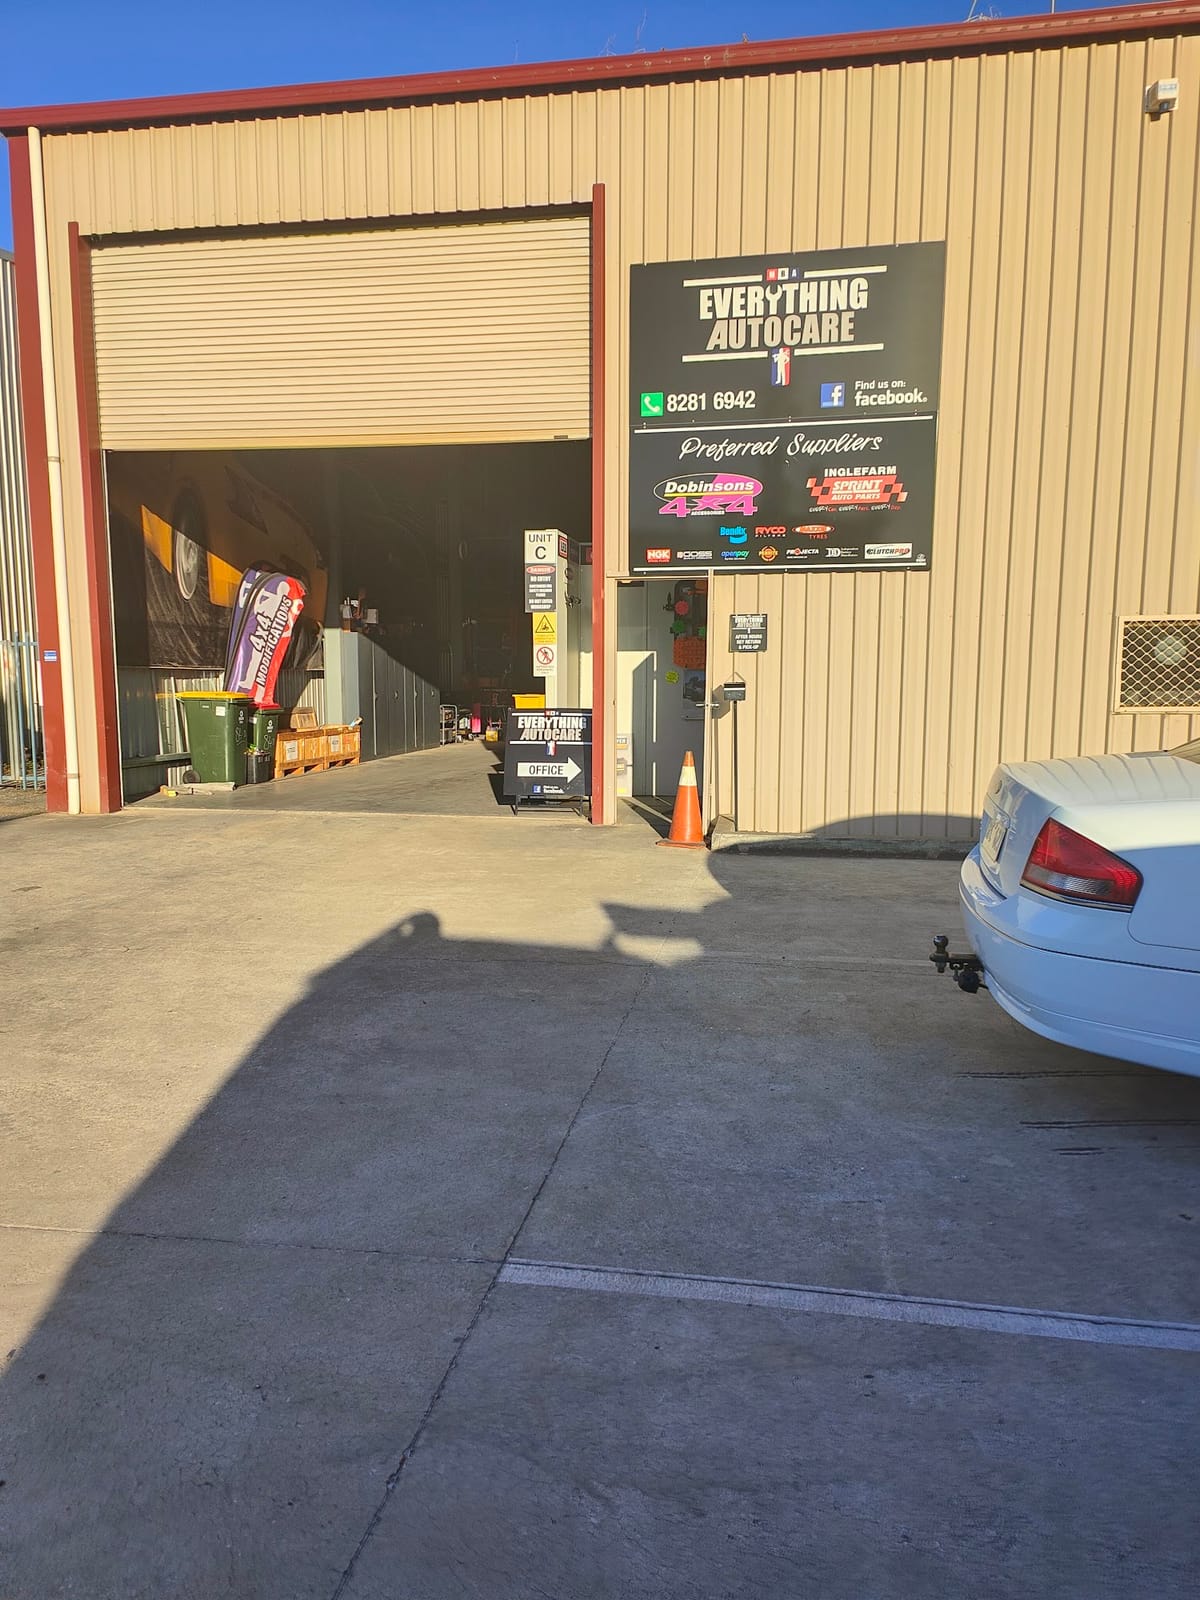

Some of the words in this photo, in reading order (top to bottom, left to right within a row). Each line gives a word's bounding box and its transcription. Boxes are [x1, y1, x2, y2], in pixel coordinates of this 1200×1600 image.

[699, 277, 869, 320] EVERYTHING
[705, 311, 856, 351] AUTOCARE
[855, 380, 876, 391] Find
[877, 381, 889, 389] us
[891, 380, 906, 388] on:
[667, 392, 707, 413] 8281
[713, 390, 756, 411] 6942
[678, 435, 781, 462] Preferred
[786, 432, 884, 458] Suppliers
[824, 465, 897, 478] INGLEFARM
[664, 480, 754, 493] Dobinsons
[719, 526, 747, 536] Bendix
[755, 526, 787, 535] RYCO
[528, 533, 553, 543] UNIT
[534, 545, 547, 560] C
[647, 549, 671, 560] NGK
[255, 594, 293, 688] MODIFICATIONS
[517, 716, 587, 730] EVERYTHING
[519, 728, 583, 741] AUTOCARE
[528, 764, 564, 776] OFFICE
